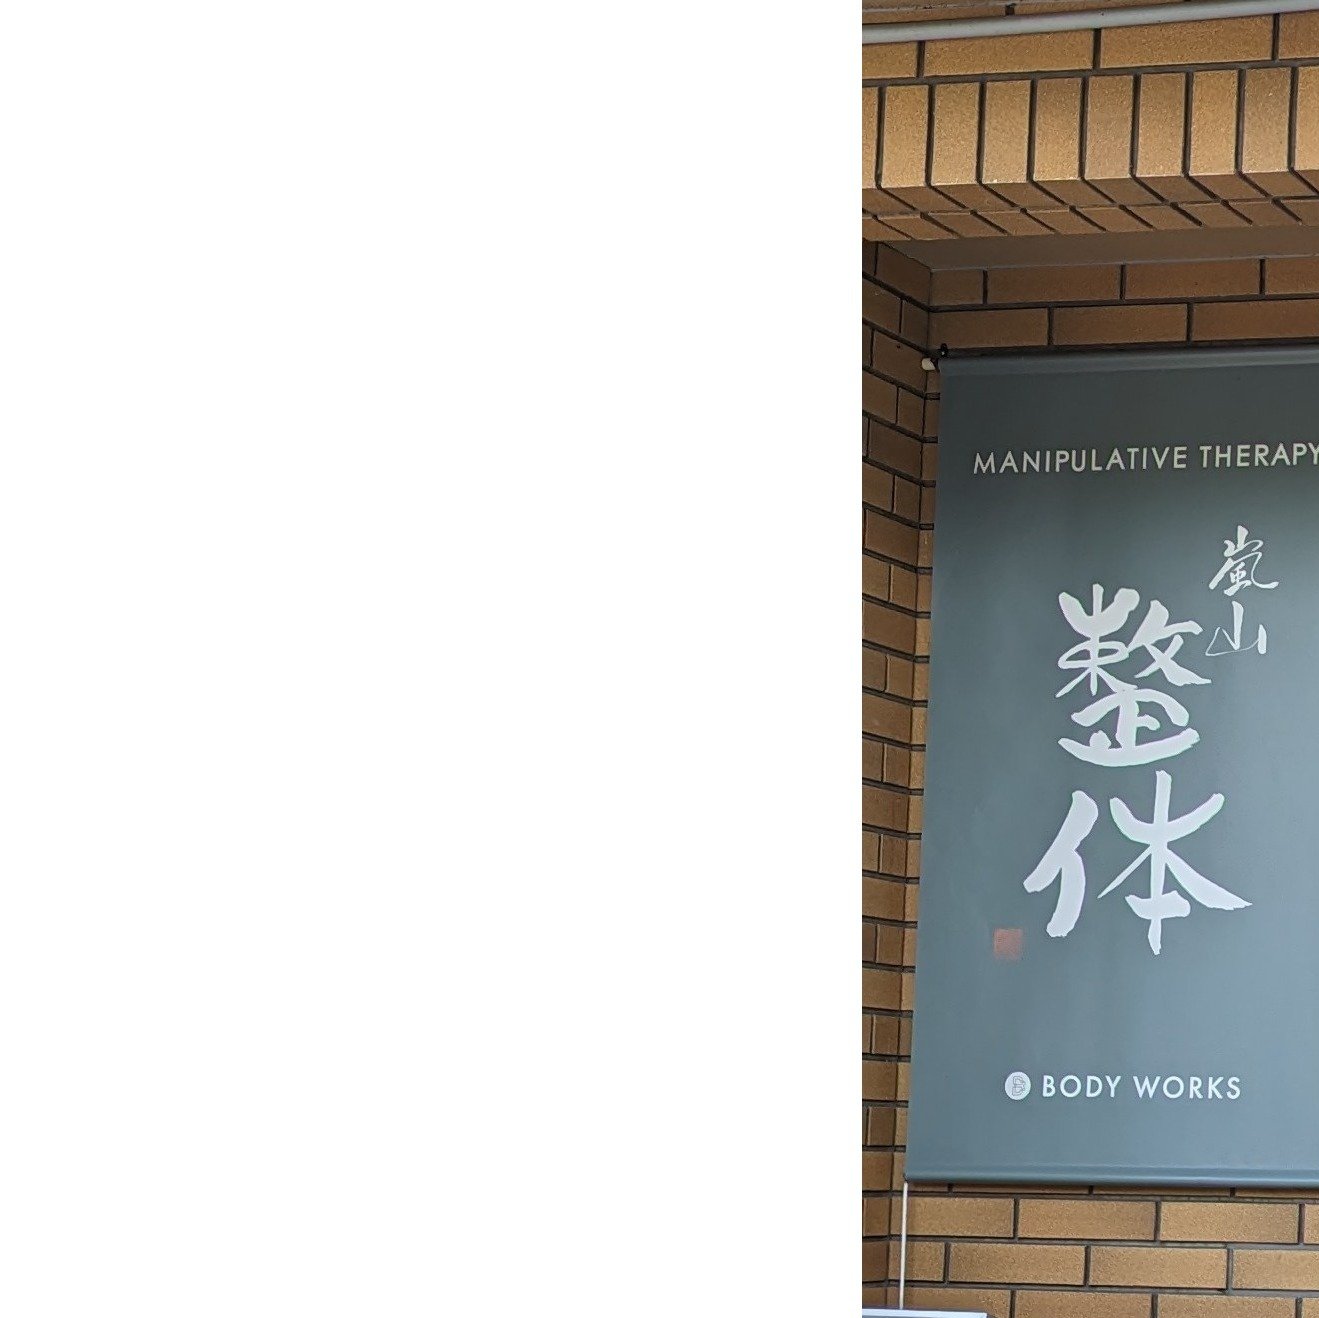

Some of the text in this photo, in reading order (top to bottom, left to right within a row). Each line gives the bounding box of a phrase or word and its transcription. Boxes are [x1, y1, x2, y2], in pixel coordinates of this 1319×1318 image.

[973, 446, 1188, 474] MANIPULATIVE
[1023, 583, 1253, 955] 整体
[1042, 1075, 1121, 1098] BODY
[1133, 1075, 1241, 1099] WORKS
